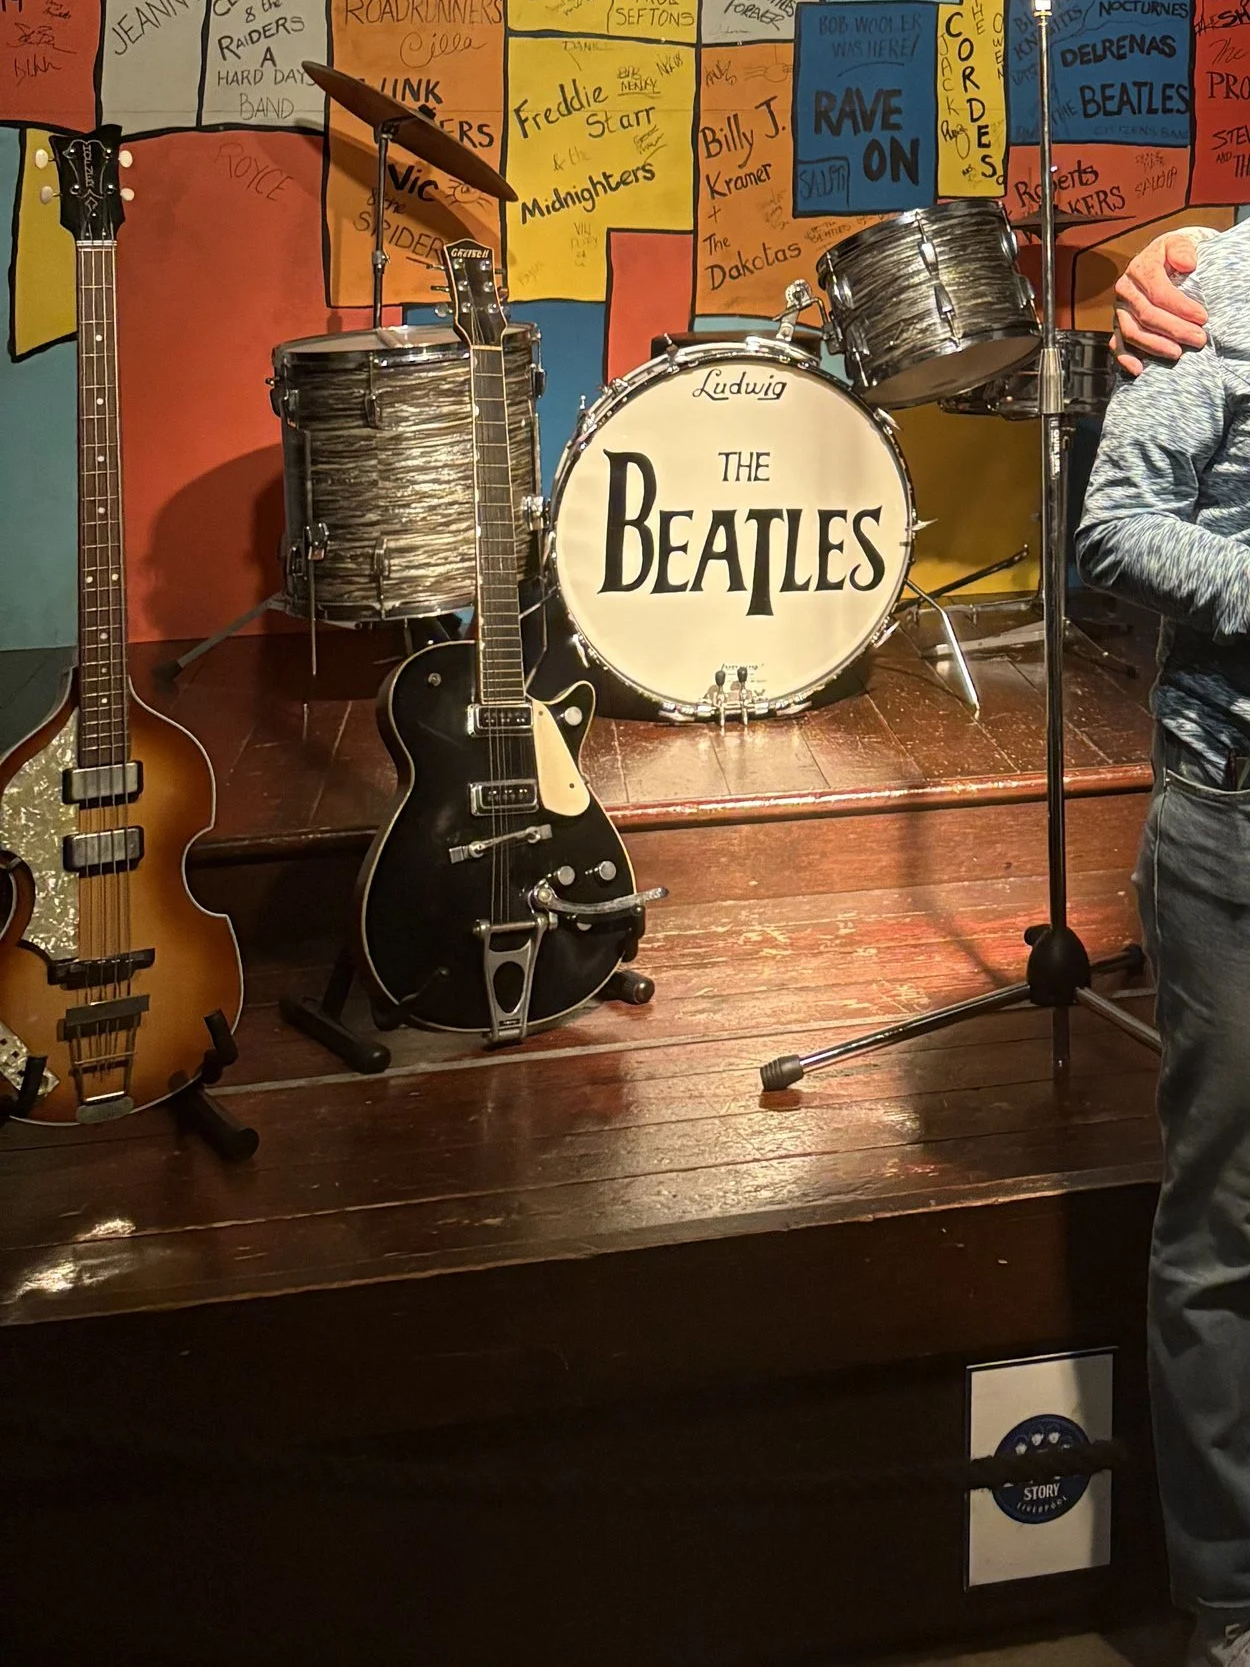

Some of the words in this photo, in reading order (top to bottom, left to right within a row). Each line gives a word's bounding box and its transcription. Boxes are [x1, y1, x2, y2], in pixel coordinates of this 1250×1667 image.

[615, 8, 695, 27] SEFTONS
[819, 14, 848, 34] BOB
[1099, 1, 1189, 19] NOCTURNES
[259, 46, 278, 69] A
[400, 32, 489, 69] Cilla
[1060, 34, 1177, 69] DELRENAS
[217, 69, 264, 87] HARD
[945, 12, 998, 179] CORDES
[239, 93, 294, 120] BAND
[514, 78, 609, 139] Freddie
[814, 87, 904, 136] RAVE
[1079, 81, 1191, 120] BEATLES
[586, 106, 656, 139] Starr
[701, 113, 754, 169] Billy
[863, 136, 920, 185] ON
[520, 162, 656, 225] Midnighters
[706, 164, 772, 201] Kramer
[703, 232, 731, 256] The
[704, 241, 802, 291] Dakotas
[692, 368, 787, 402] Ludwig
[718, 451, 771, 482] THE
[597, 448, 886, 617] BEATLES
[1024, 1483, 1060, 1501] STORY
